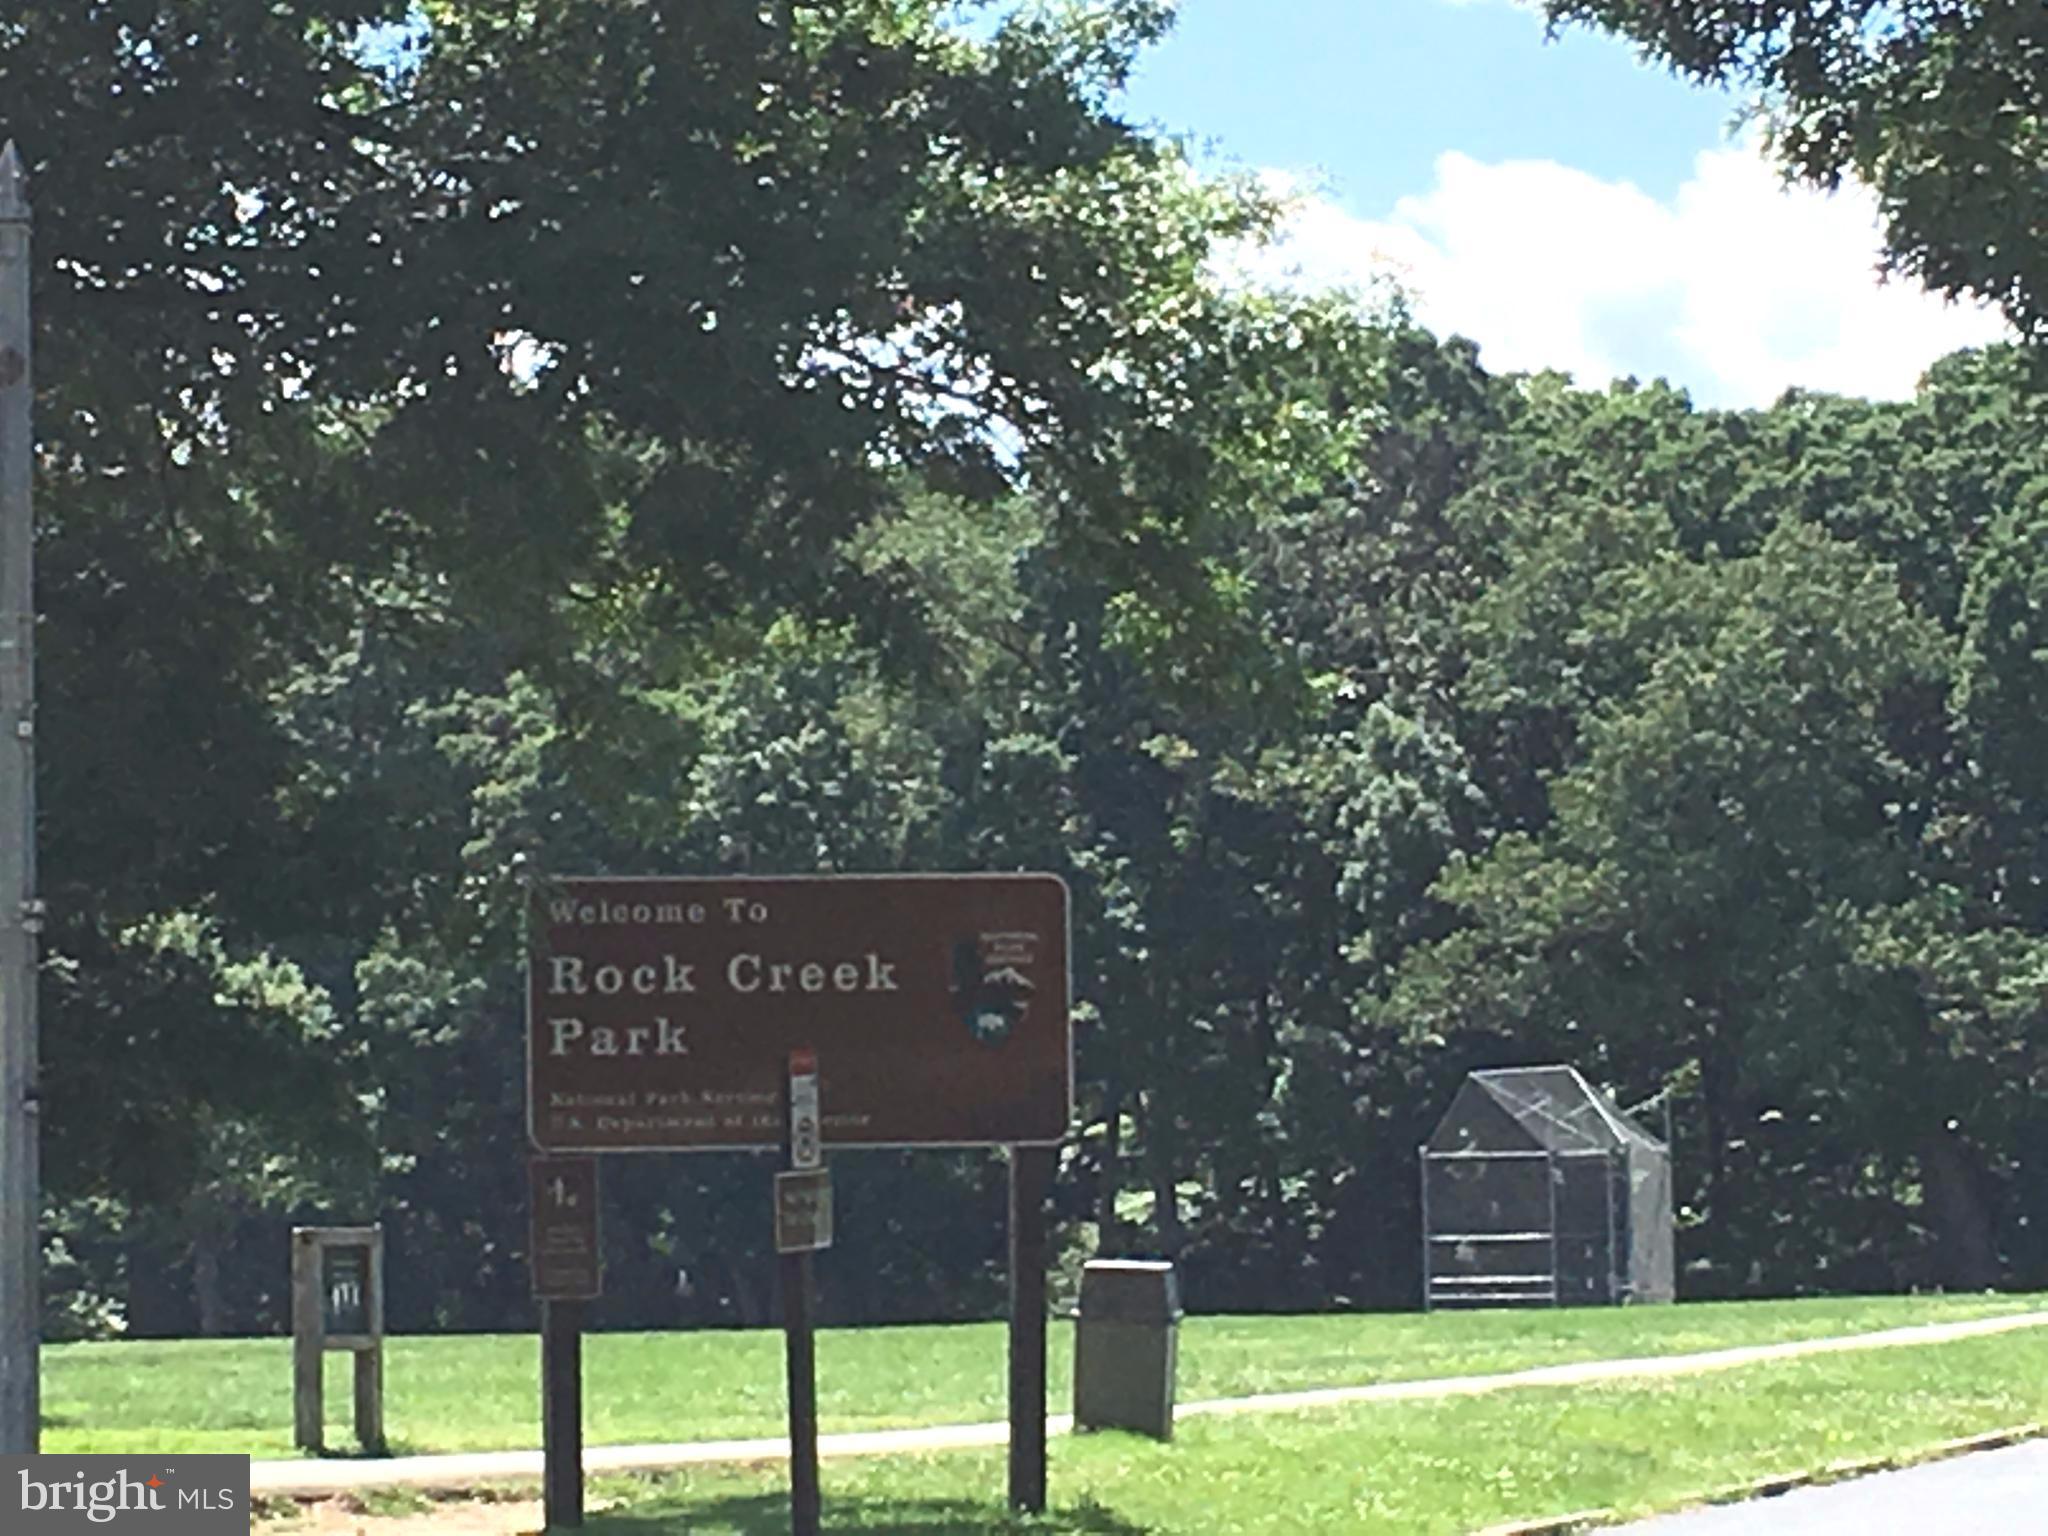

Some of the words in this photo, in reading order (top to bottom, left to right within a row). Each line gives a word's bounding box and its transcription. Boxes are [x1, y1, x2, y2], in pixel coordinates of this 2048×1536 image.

[549, 899, 706, 923] Welcome
[723, 897, 769, 922] To
[548, 953, 697, 995] Rock
[727, 951, 899, 993] Creek
[547, 1015, 690, 1056] Park
